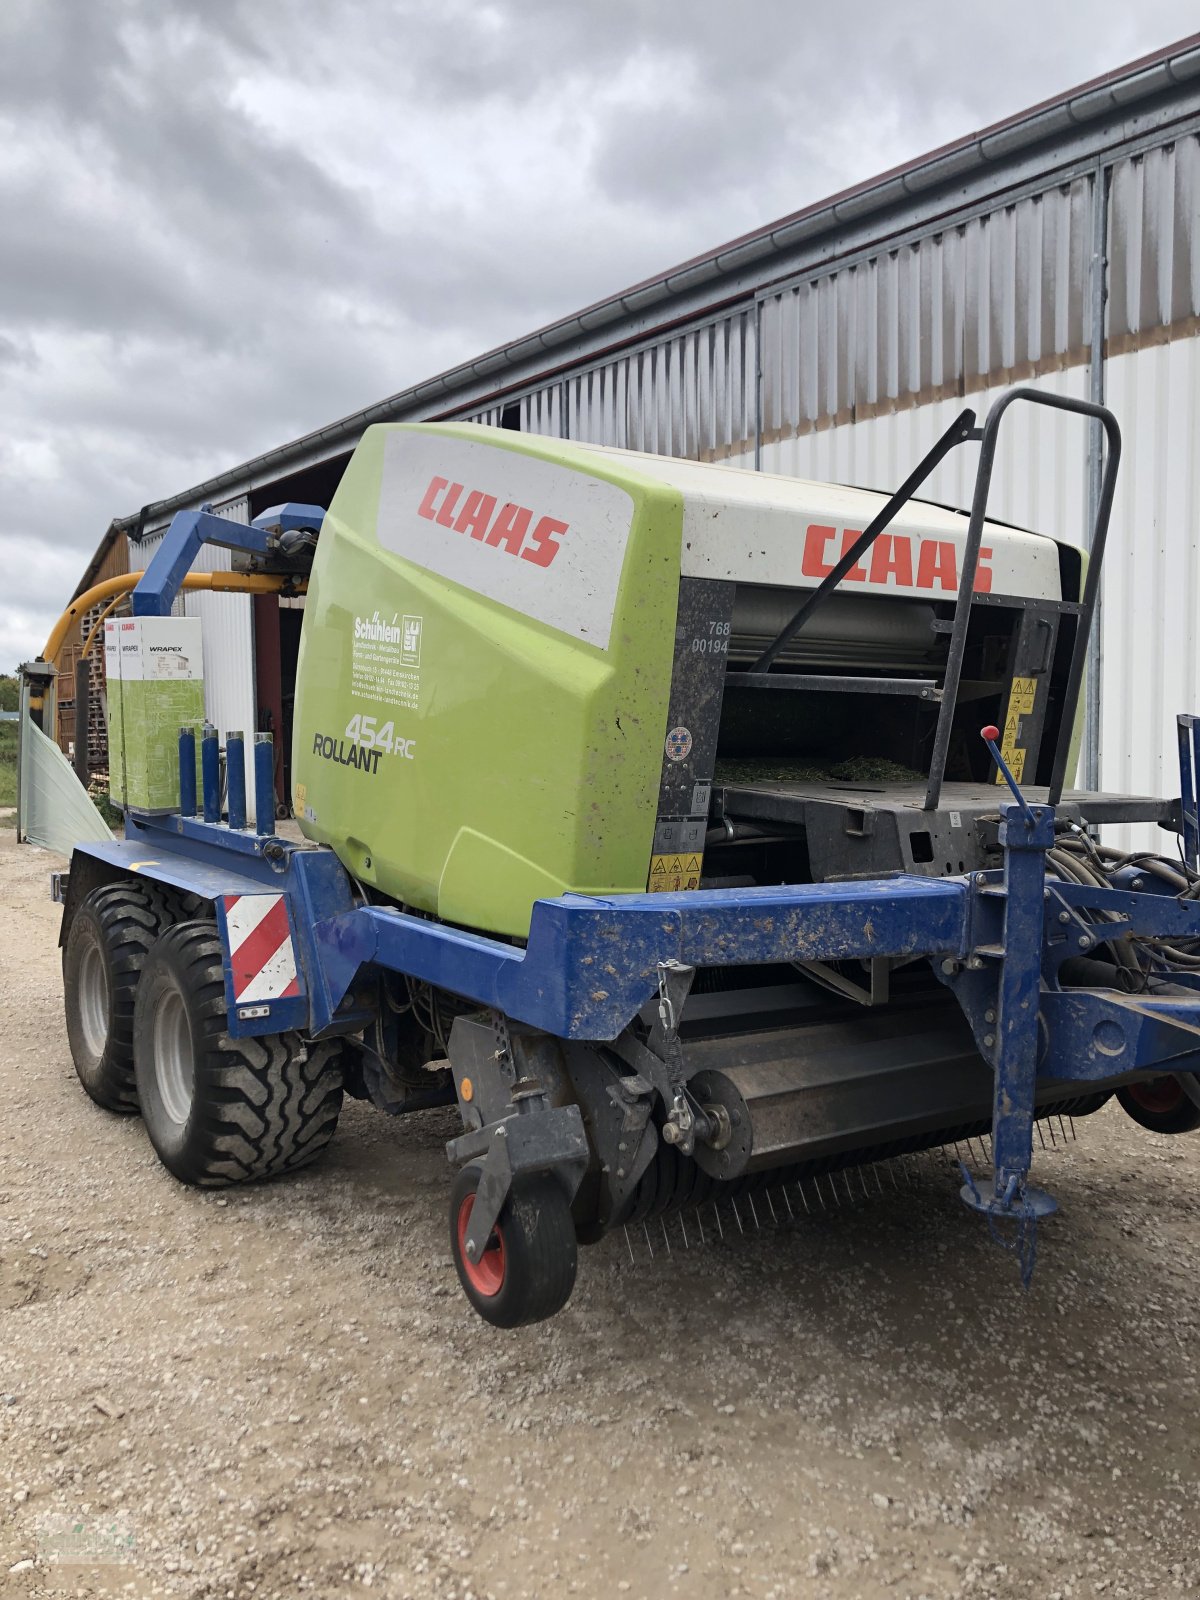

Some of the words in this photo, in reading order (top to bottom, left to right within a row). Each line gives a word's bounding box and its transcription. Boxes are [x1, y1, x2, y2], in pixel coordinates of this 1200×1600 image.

[417, 475, 570, 568] CLAAS
[801, 524, 993, 594] CLAAS
[354, 611, 401, 644] Schühlein
[691, 638, 729, 654] 00194
[709, 621, 730, 636] 768
[312, 732, 383, 775] ROLLANT
[345, 713, 395, 754] 454
[393, 736, 417, 760] RC
